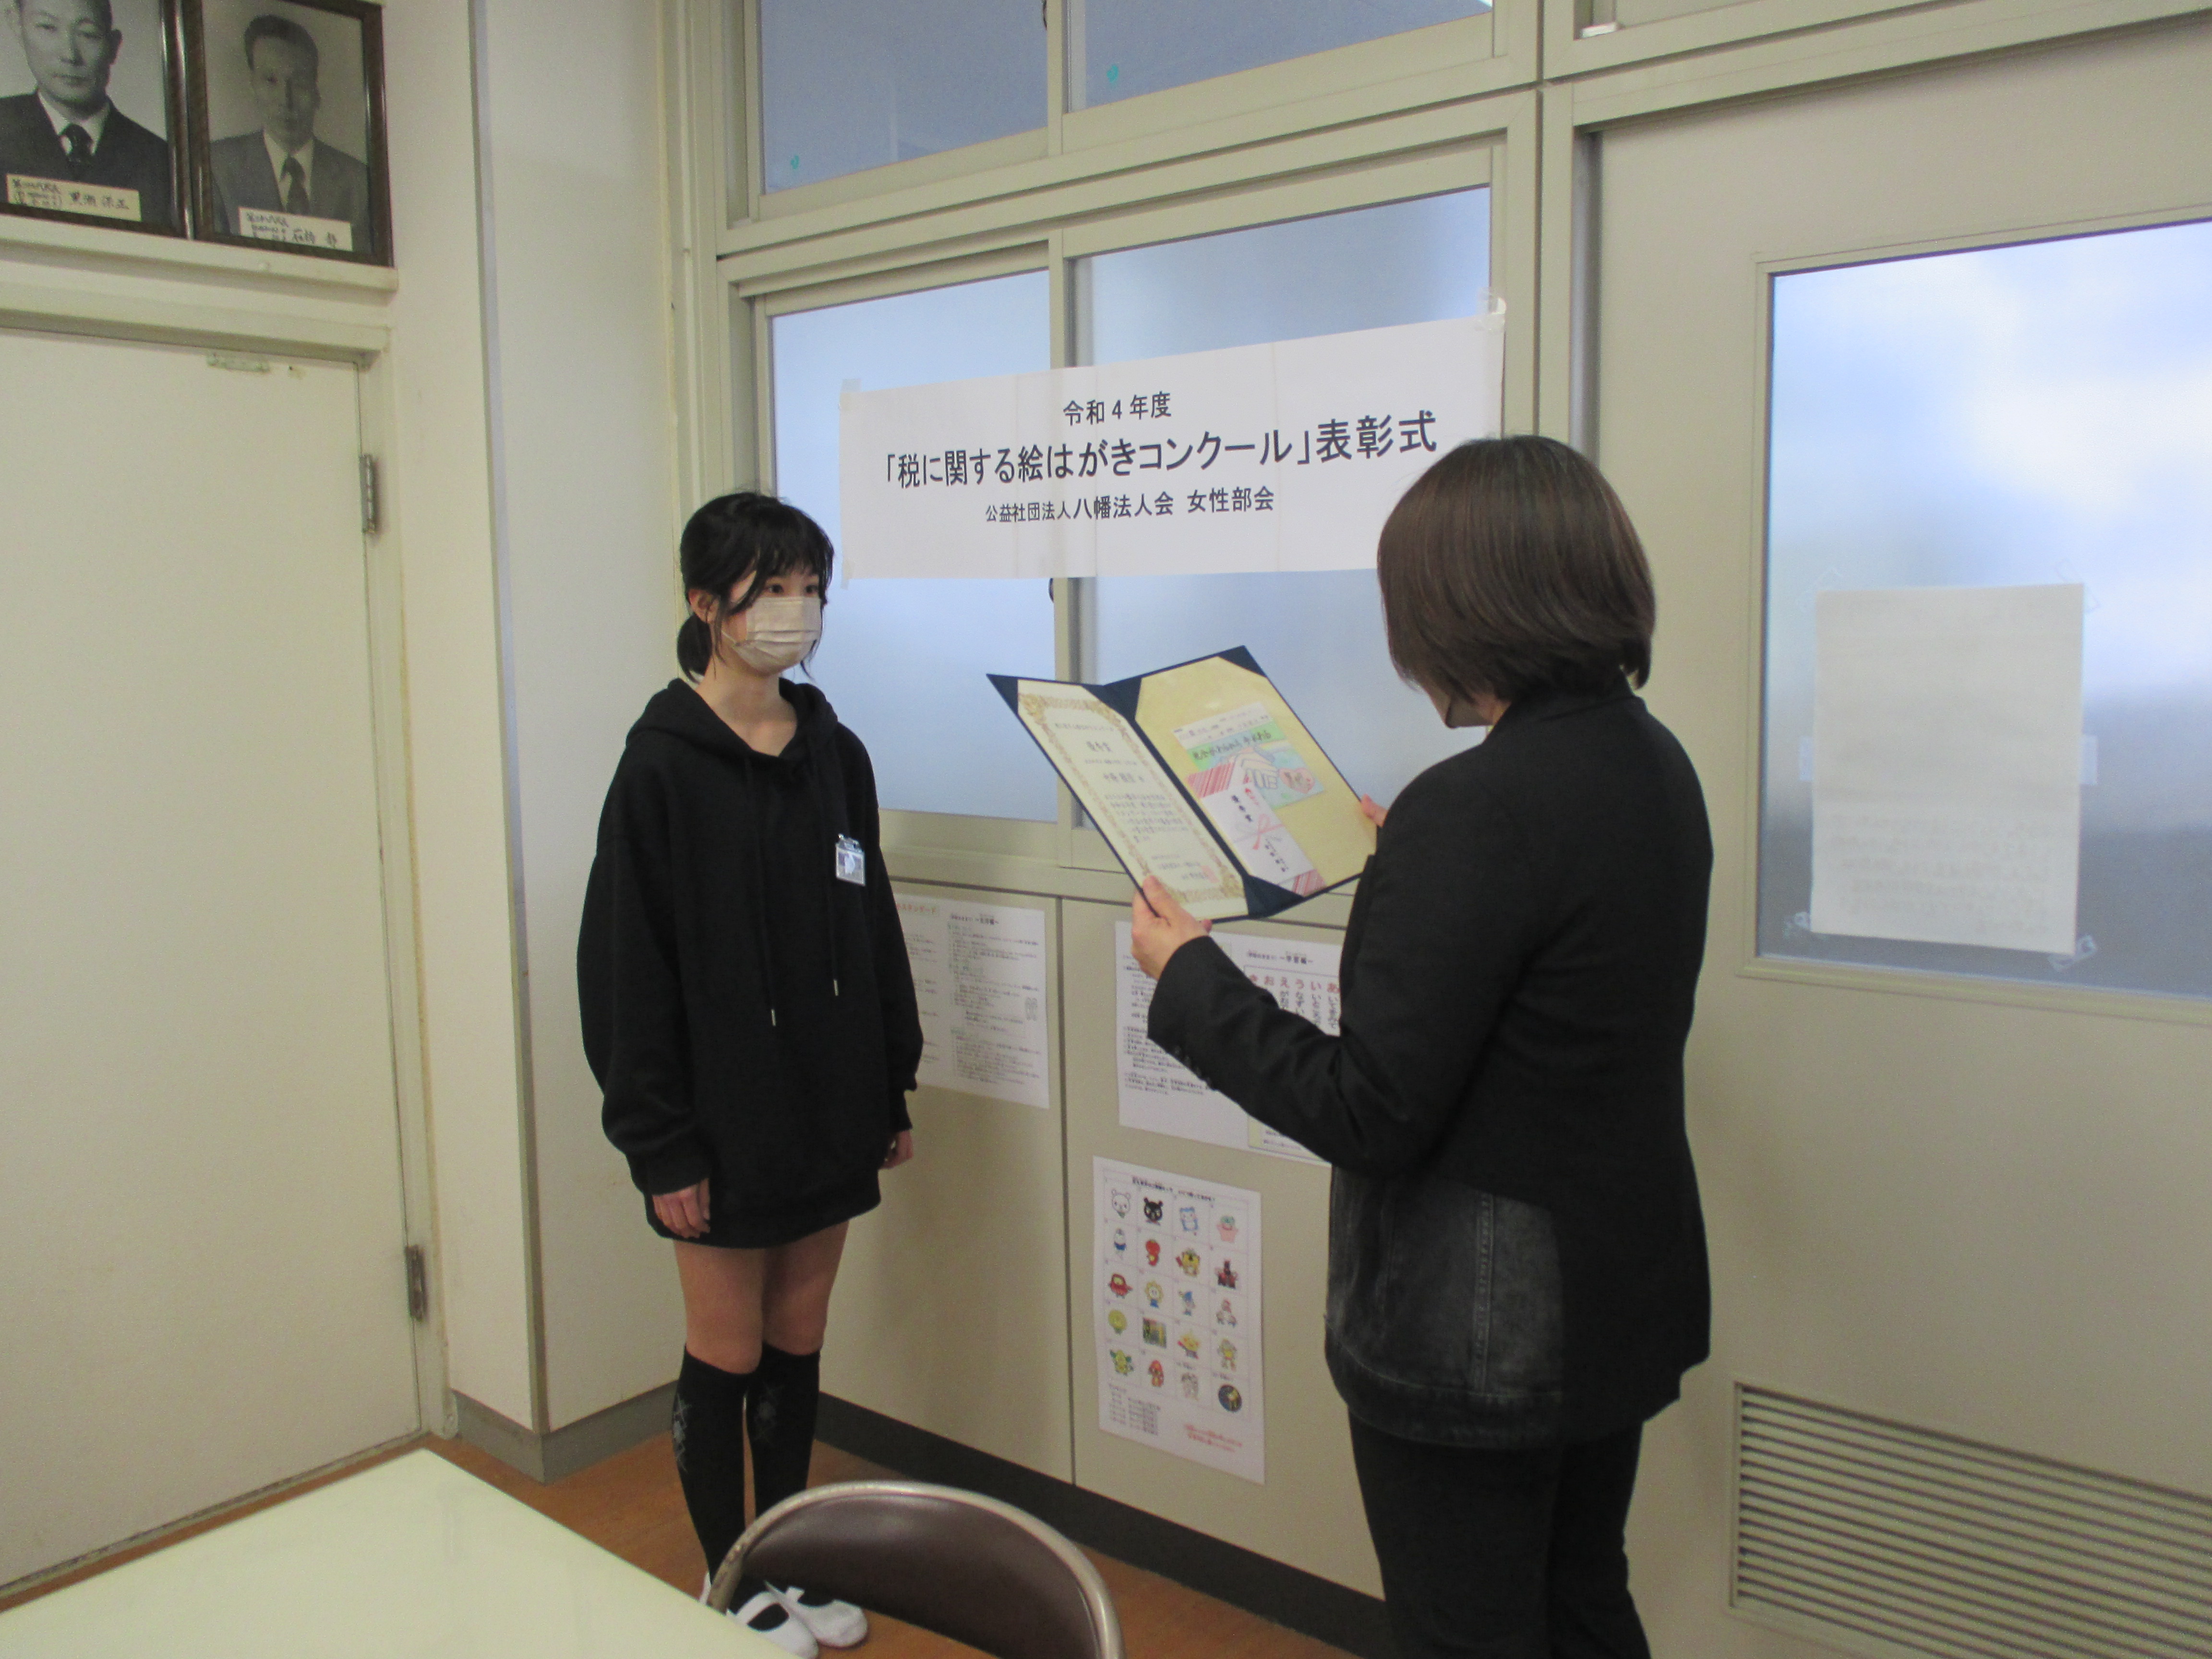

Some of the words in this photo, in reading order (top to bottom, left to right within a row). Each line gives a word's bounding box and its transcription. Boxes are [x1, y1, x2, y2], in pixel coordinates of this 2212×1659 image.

[1063, 390, 1172, 426] 令和4年度
[887, 409, 1437, 489] 「税に関する絵はがきコンクール」表彰式
[985, 490, 1174, 523] 公益社団法人八幡法人会
[1187, 485, 1274, 514] 女性部会
